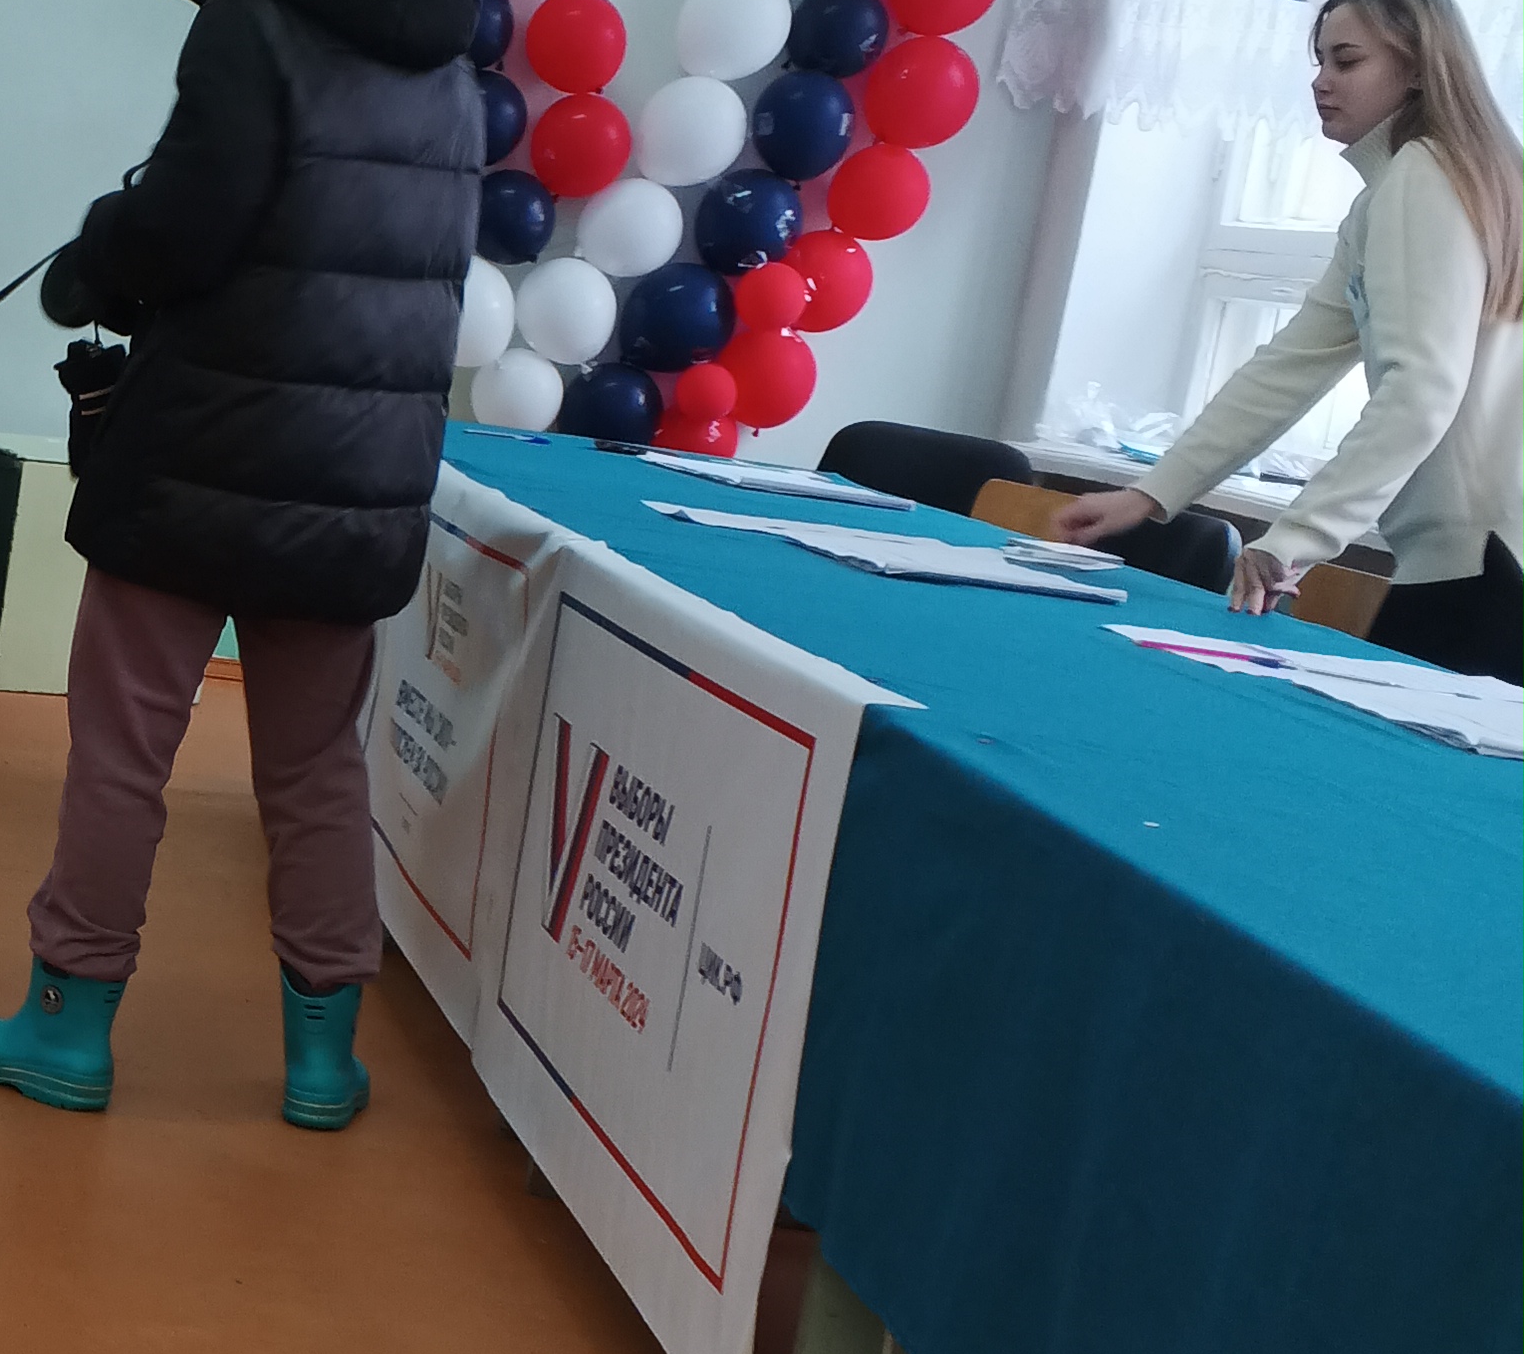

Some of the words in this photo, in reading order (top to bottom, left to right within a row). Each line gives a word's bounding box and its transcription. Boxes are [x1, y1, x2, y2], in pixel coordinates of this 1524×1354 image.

[608, 763, 676, 847] ВЫБОРЫ
[578, 872, 637, 954] РОССИИ
[593, 818, 685, 928] ПРЕЗИДЕНТА
